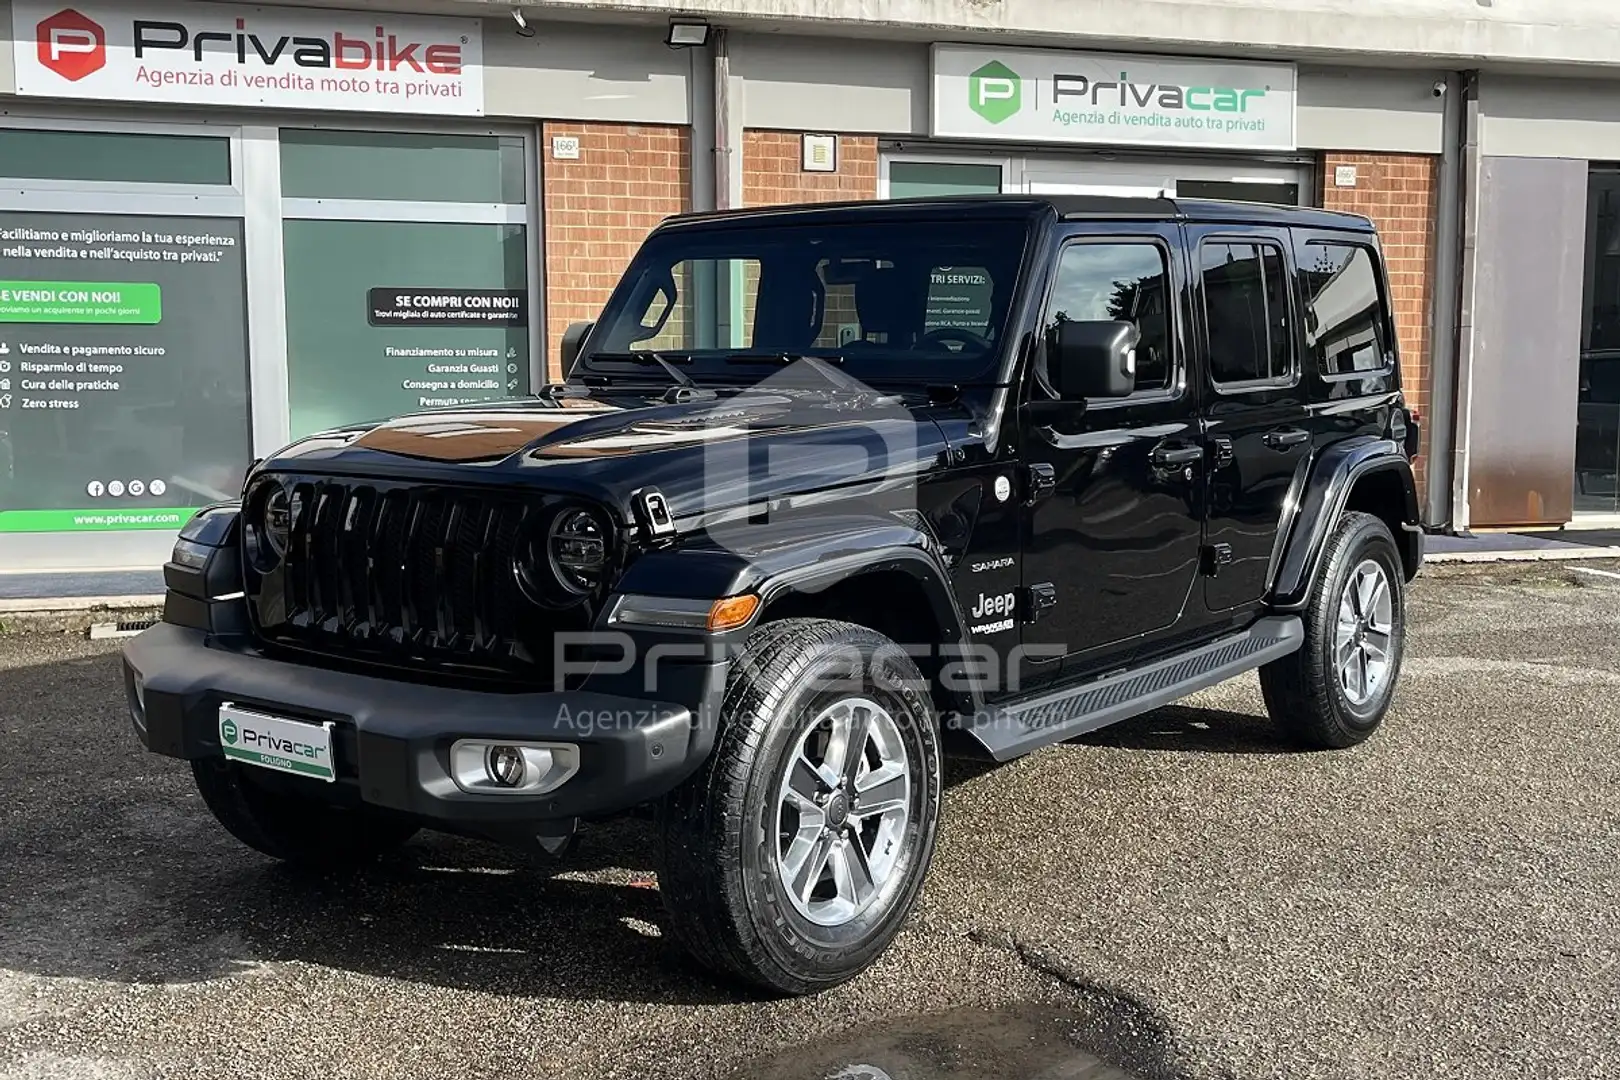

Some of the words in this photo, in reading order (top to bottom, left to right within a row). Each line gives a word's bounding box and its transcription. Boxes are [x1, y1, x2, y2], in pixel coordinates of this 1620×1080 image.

[133, 18, 462, 75] Privabike
[136, 65, 215, 88] Agenzia
[220, 69, 238, 87] di
[243, 70, 315, 91] vendita
[321, 77, 370, 93] moto
[375, 79, 400, 95] tra
[405, 80, 462, 100] privati
[1053, 72, 1266, 113] Privacar
[1053, 109, 1105, 125] Agenzia
[1108, 111, 1121, 125] di
[1123, 112, 1172, 128] vendita
[1174, 116, 1203, 129] auto
[1206, 117, 1223, 130] tra
[1226, 118, 1266, 133] privati
[61, 232, 69, 241] e
[70, 229, 140, 245] miglioriamo
[141, 231, 152, 243] la
[154, 233, 172, 243] tua
[175, 233, 235, 247] esperienza
[3, 246, 32, 258] nella
[34, 246, 78, 258] vendita
[80, 249, 88, 258] e
[89, 247, 160, 262] nell'acquisto
[162, 250, 178, 261] tra
[947, 275, 986, 285] SERVIZI:
[0, 290, 10, 301] E
[13, 290, 56, 302] VENDI
[58, 291, 88, 302] CON
[91, 292, 121, 304] NOI!
[395, 296, 411, 307] SE
[413, 296, 462, 308] COMPRI
[464, 296, 491, 308] CON
[492, 297, 519, 308] NOI!
[0, 305, 29, 314] oviamo
[31, 307, 42, 315] un
[43, 306, 84, 316] acquirente
[86, 307, 93, 315] in
[95, 306, 116, 317] pochi
[118, 307, 140, 317] giorni
[374, 310, 393, 318] Trovi
[393, 310, 421, 320] migliaia
[421, 310, 429, 318] di
[447, 310, 481, 318] certificate
[20, 343, 61, 354] Vendita
[63, 346, 70, 354] e
[72, 345, 132, 356] pagamento
[134, 345, 165, 355] sicuro
[386, 347, 454, 357] Finanziamento
[455, 349, 466, 357] su
[467, 347, 498, 357] misura
[21, 362, 75, 374] Risparmio
[76, 362, 87, 372] di
[88, 363, 123, 374] tempo
[427, 364, 467, 373] Garanzia
[469, 364, 499, 373] Guasti
[21, 380, 46, 391] Cura
[48, 380, 74, 391] delle
[76, 380, 120, 392] pratiche
[403, 380, 448, 391] Consegna
[457, 380, 500, 389] domicilio
[22, 399, 47, 409] Zero
[49, 399, 79, 409] stress
[420, 397, 458, 406] Permuta
[74, 513, 179, 525] www.privacar.com
[972, 557, 1015, 573] SAHARA
[971, 592, 1015, 618] Jeep
[243, 729, 326, 759] Privacar
[260, 754, 292, 769] FOLIGNO
